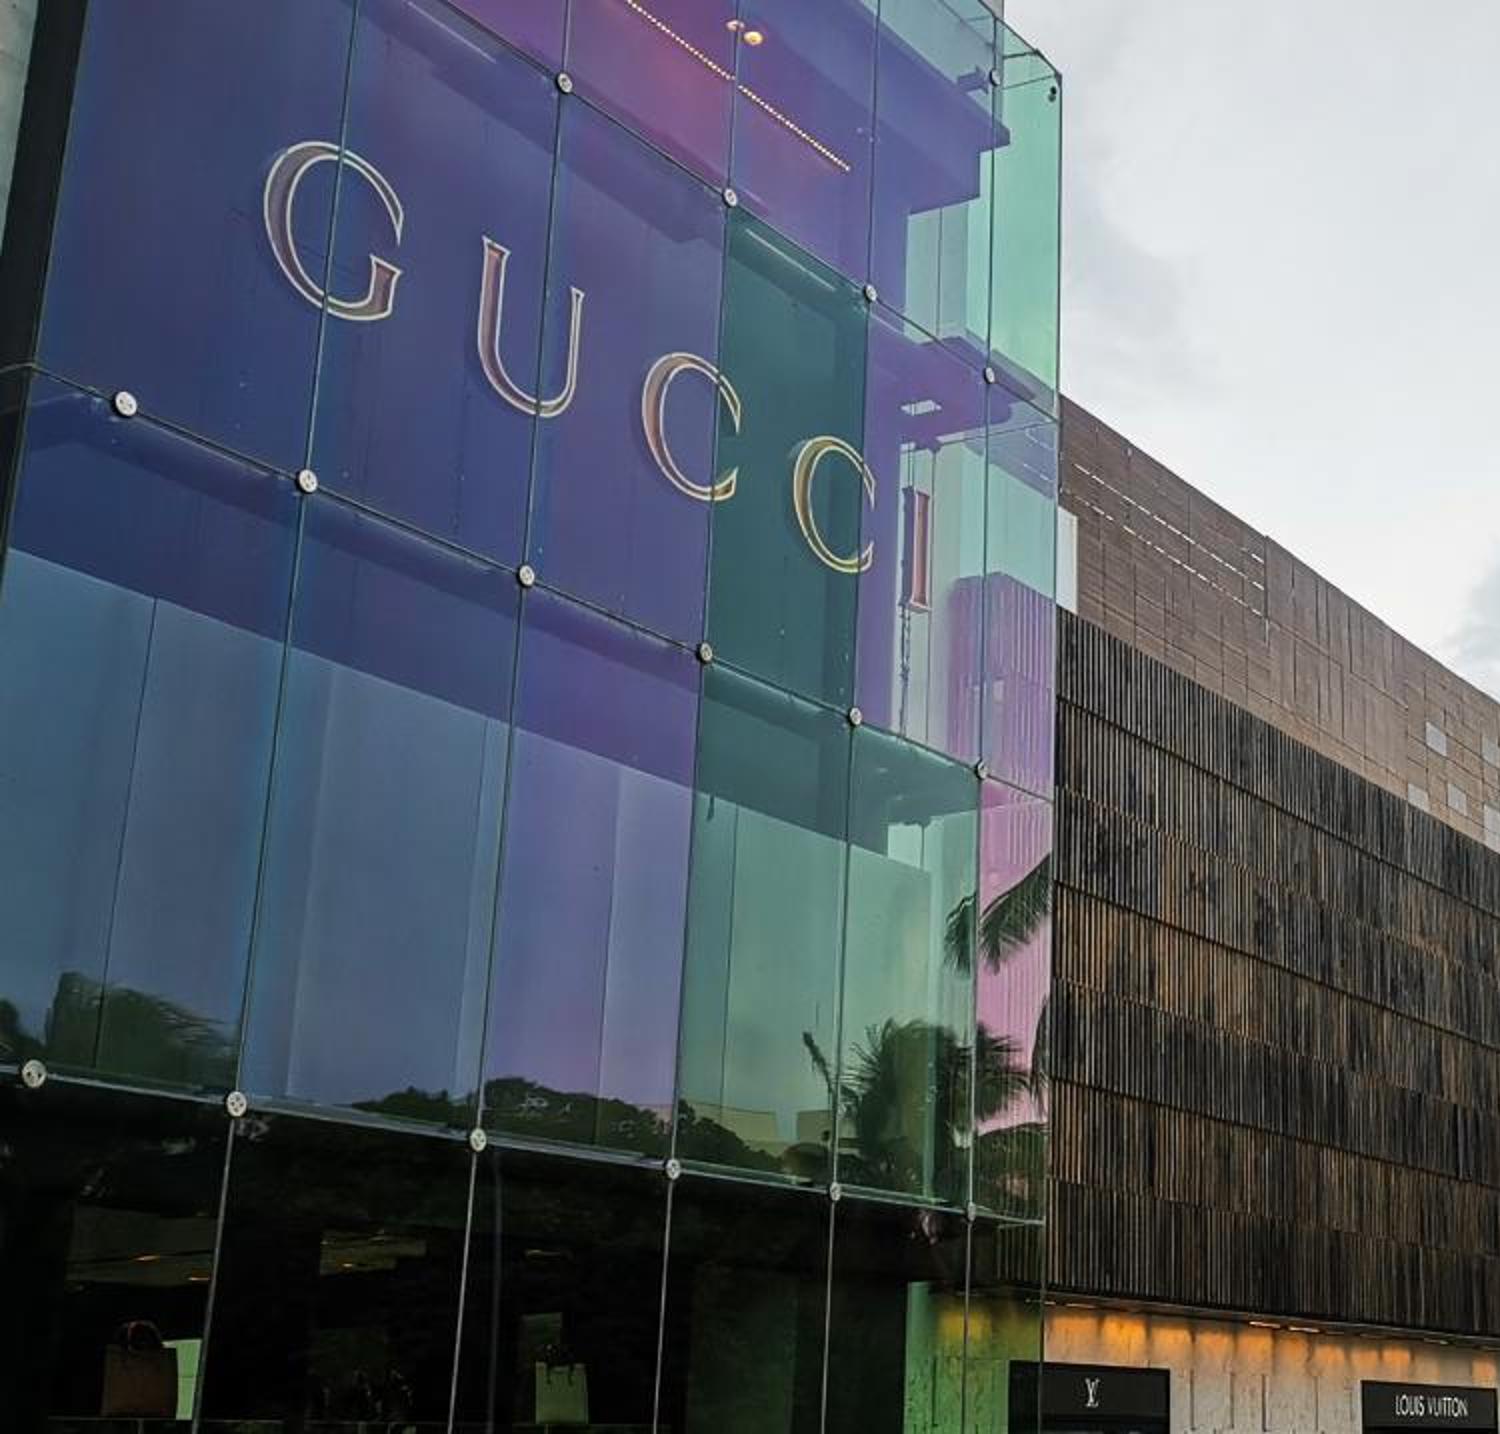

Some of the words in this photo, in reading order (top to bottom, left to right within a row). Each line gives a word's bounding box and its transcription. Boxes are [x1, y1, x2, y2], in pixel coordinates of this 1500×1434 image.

[263, 141, 933, 613] GUCCI
[1395, 1394, 1425, 1417] LOUIS
[1426, 1396, 1469, 1417] VUITTON
